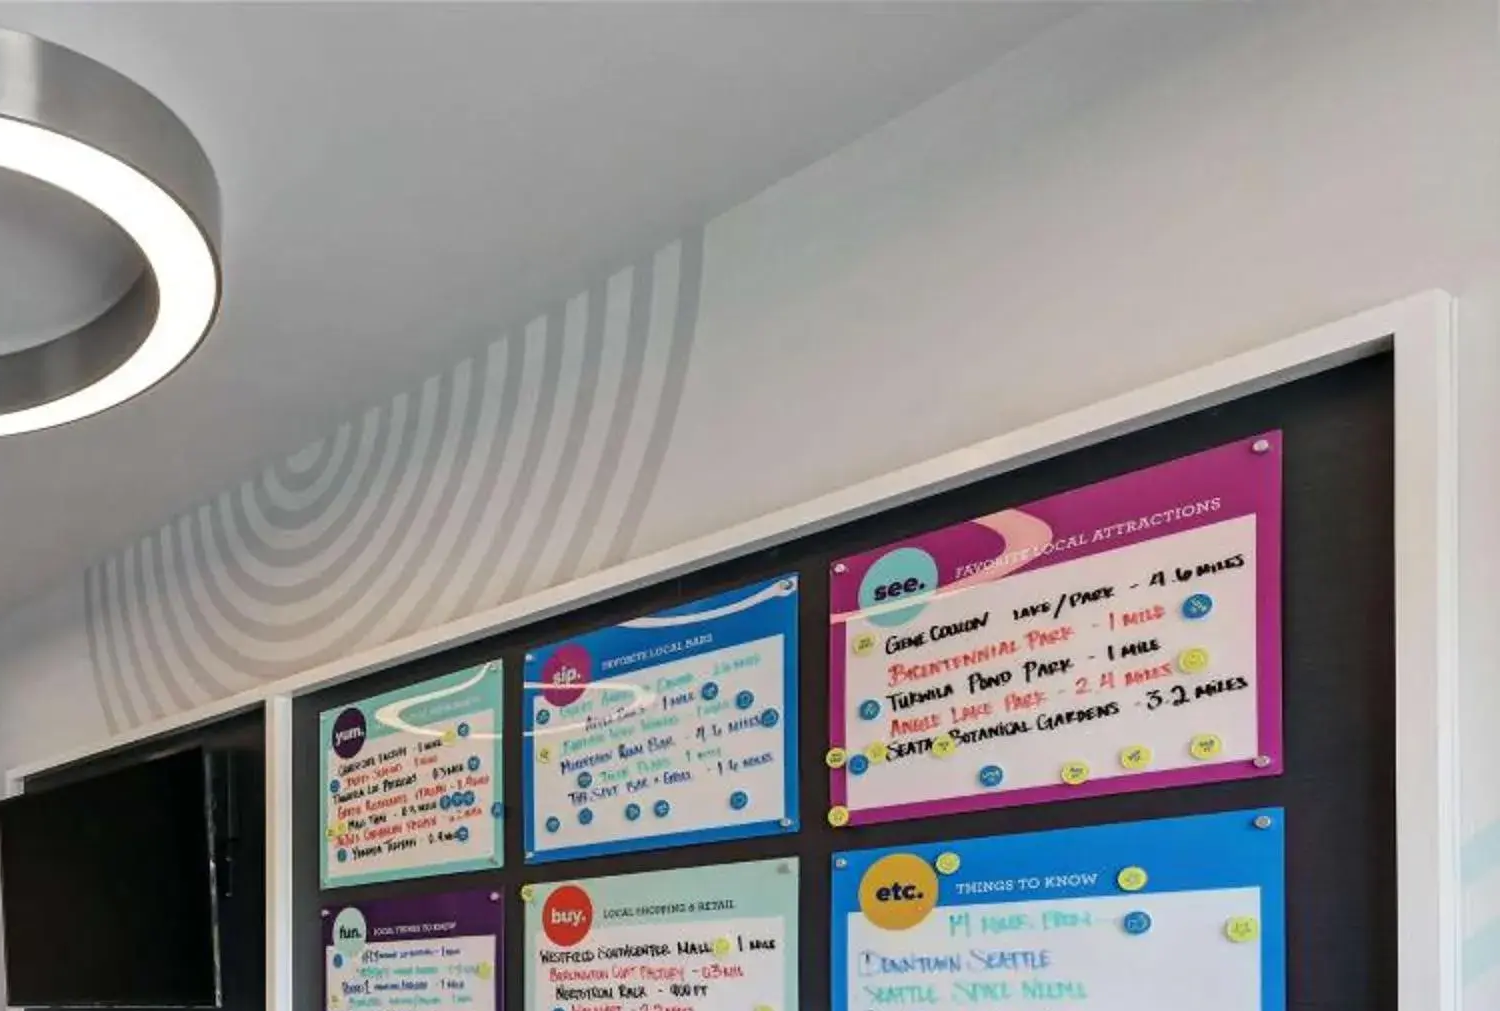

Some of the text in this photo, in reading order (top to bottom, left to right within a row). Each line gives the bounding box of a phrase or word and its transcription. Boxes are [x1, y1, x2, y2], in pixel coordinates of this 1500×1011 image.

[1033, 535, 1088, 556] LOCAL
[1091, 497, 1221, 543] ATTRACTIONS
[874, 577, 925, 602] see.
[1025, 625, 1074, 651] PARK
[967, 670, 1012, 695] POND
[1023, 658, 1074, 683] PARK
[1036, 701, 1120, 732] GARDENS
[875, 882, 924, 902] etc.
[955, 872, 1099, 895] THINGS TO KNOW
[551, 906, 586, 926] buy.
[603, 907, 634, 920] LOCAL
[698, 900, 737, 911] RETAIL
